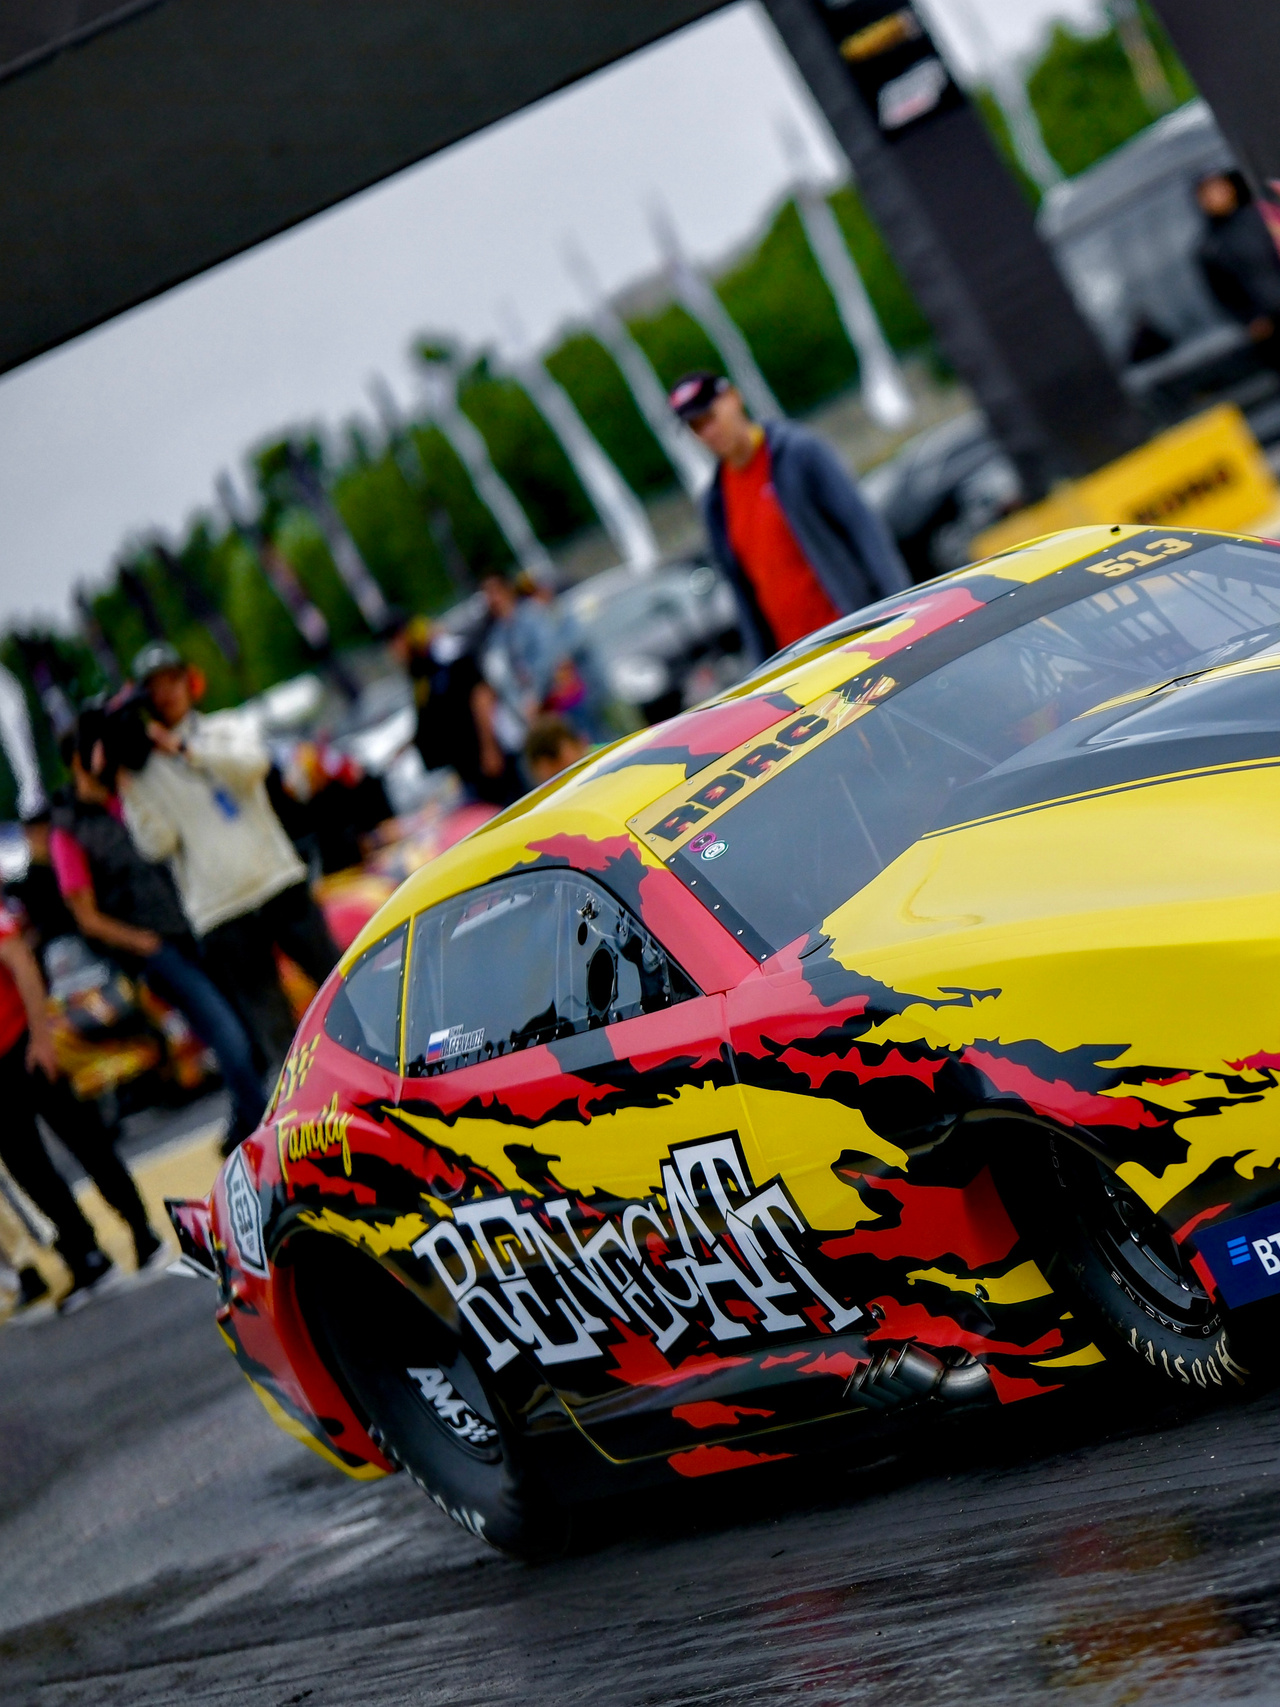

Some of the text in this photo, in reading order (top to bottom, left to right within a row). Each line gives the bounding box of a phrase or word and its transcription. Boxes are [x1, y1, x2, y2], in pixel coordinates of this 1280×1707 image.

[1085, 537, 1193, 577] 513
[277, 1091, 355, 1184] Family
[1110, 1270, 1182, 1334] RACING
